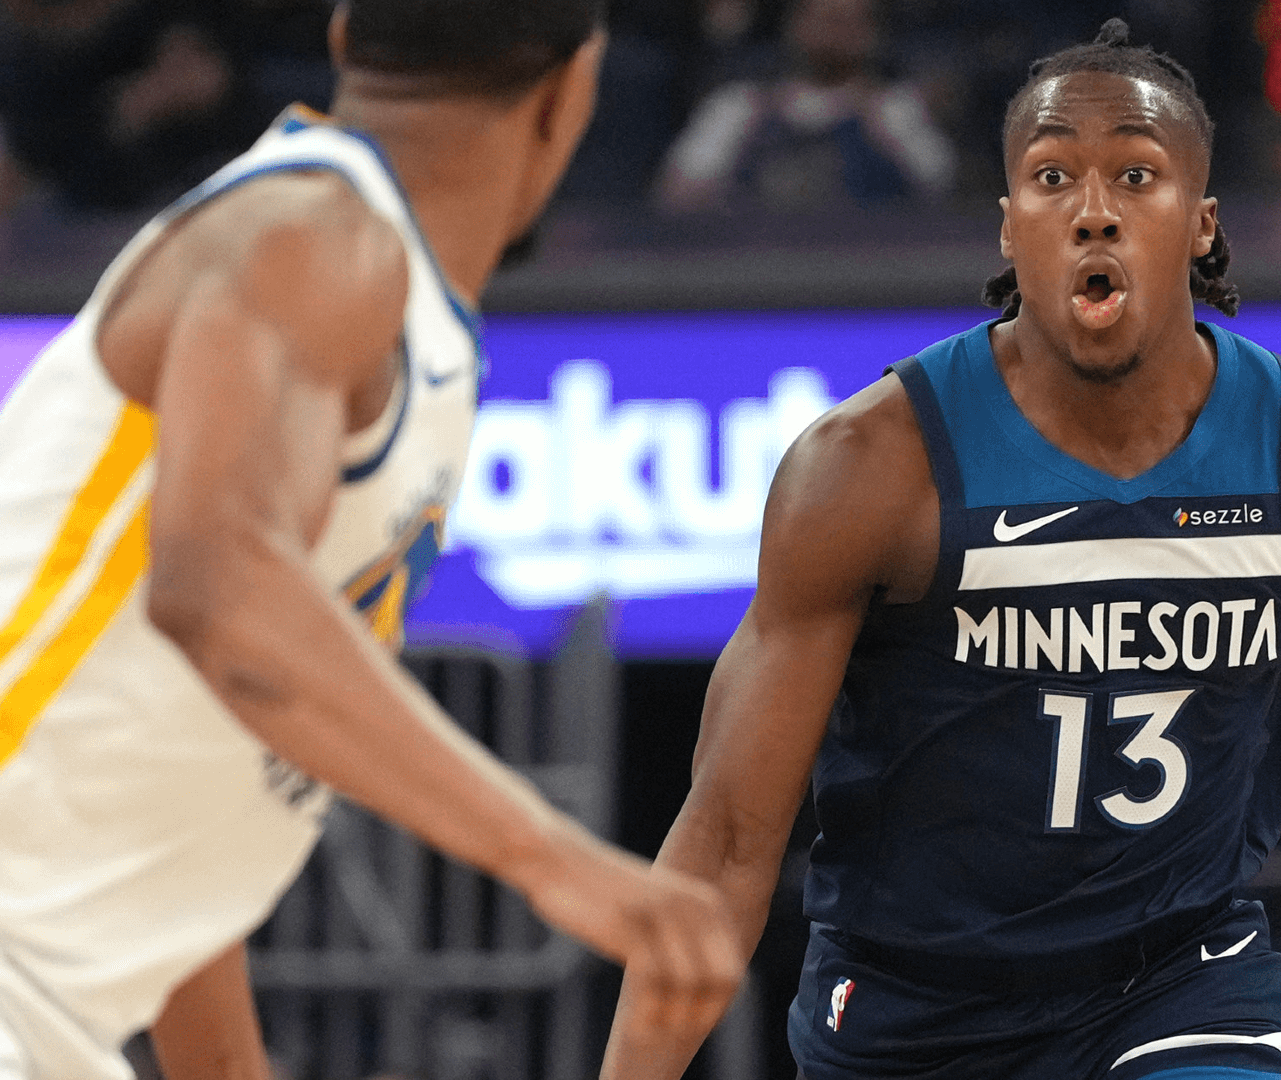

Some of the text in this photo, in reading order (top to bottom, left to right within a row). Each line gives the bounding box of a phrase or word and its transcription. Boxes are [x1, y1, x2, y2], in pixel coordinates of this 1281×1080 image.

[1190, 503, 1263, 525] sezzle
[954, 599, 1278, 673] MINNESOTA
[1039, 688, 1203, 833] 13
